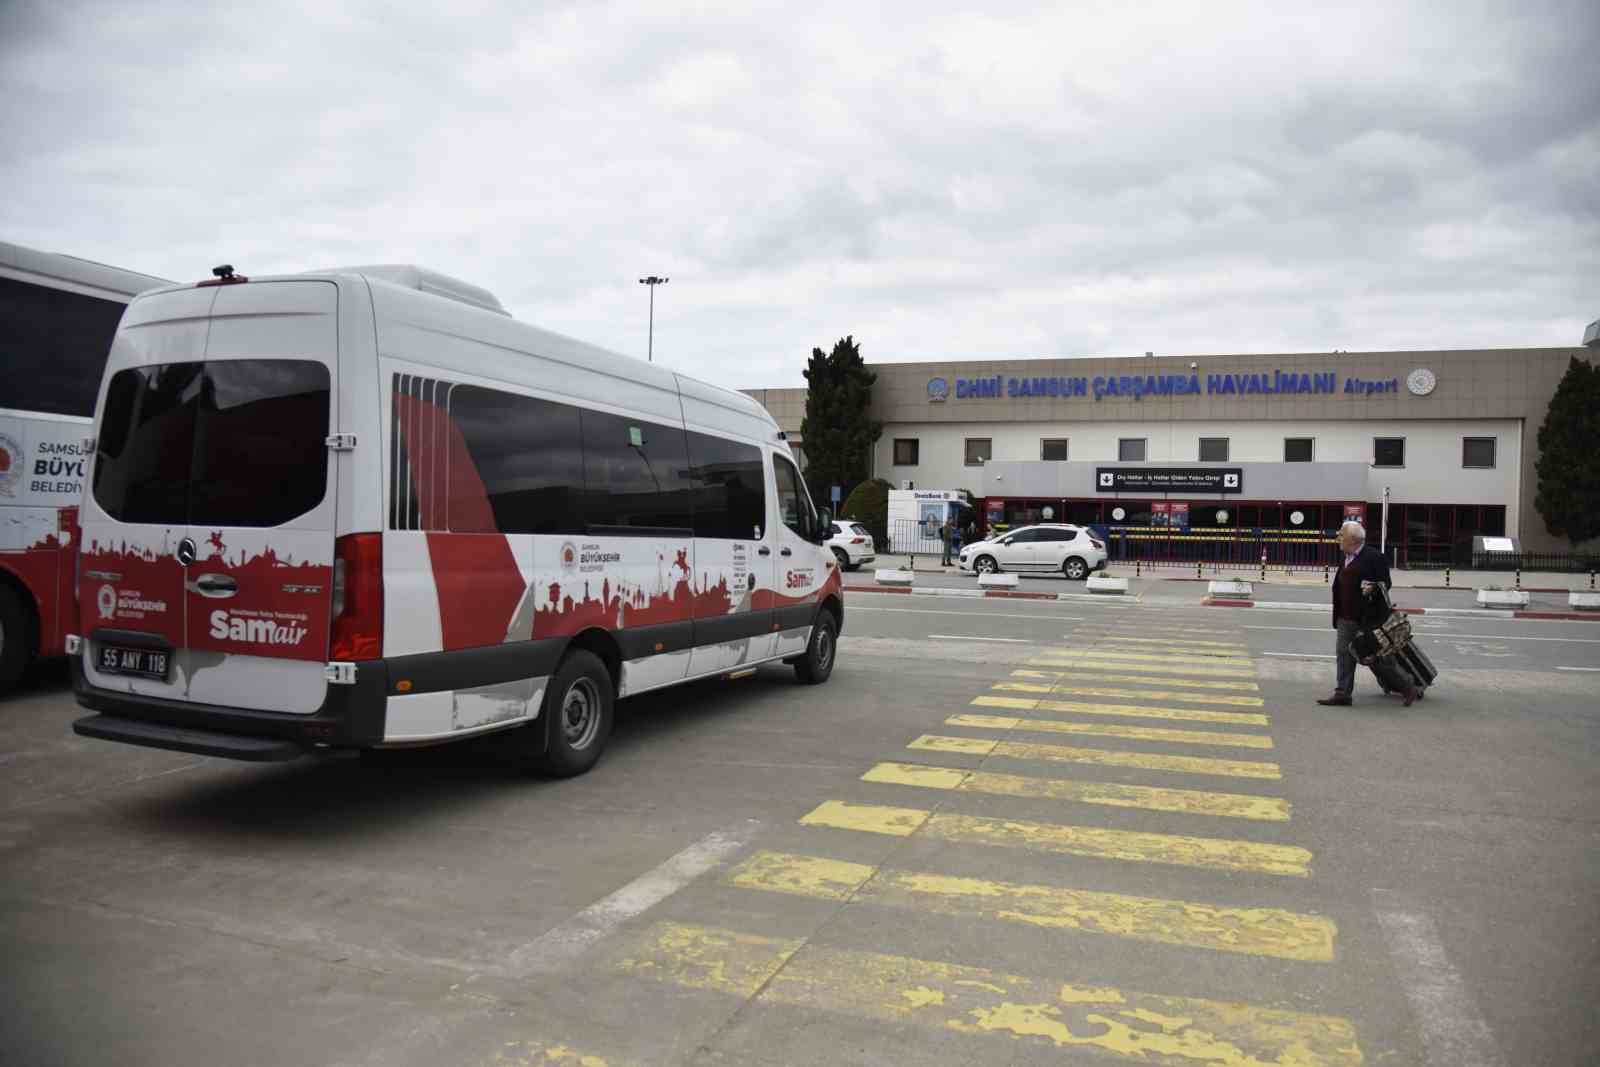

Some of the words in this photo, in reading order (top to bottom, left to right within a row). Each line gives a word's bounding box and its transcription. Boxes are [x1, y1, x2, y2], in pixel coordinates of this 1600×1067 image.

[1007, 377, 1088, 398] SAMSUN
[1092, 375, 1200, 401] ÇARŞAMBA
[1207, 370, 1336, 394] HAVALİMANI
[1344, 377, 1398, 396] Airport
[209, 609, 307, 645] Samair
[103, 649, 117, 667] 55
[121, 651, 142, 671] ANY
[149, 653, 166, 673] 118
